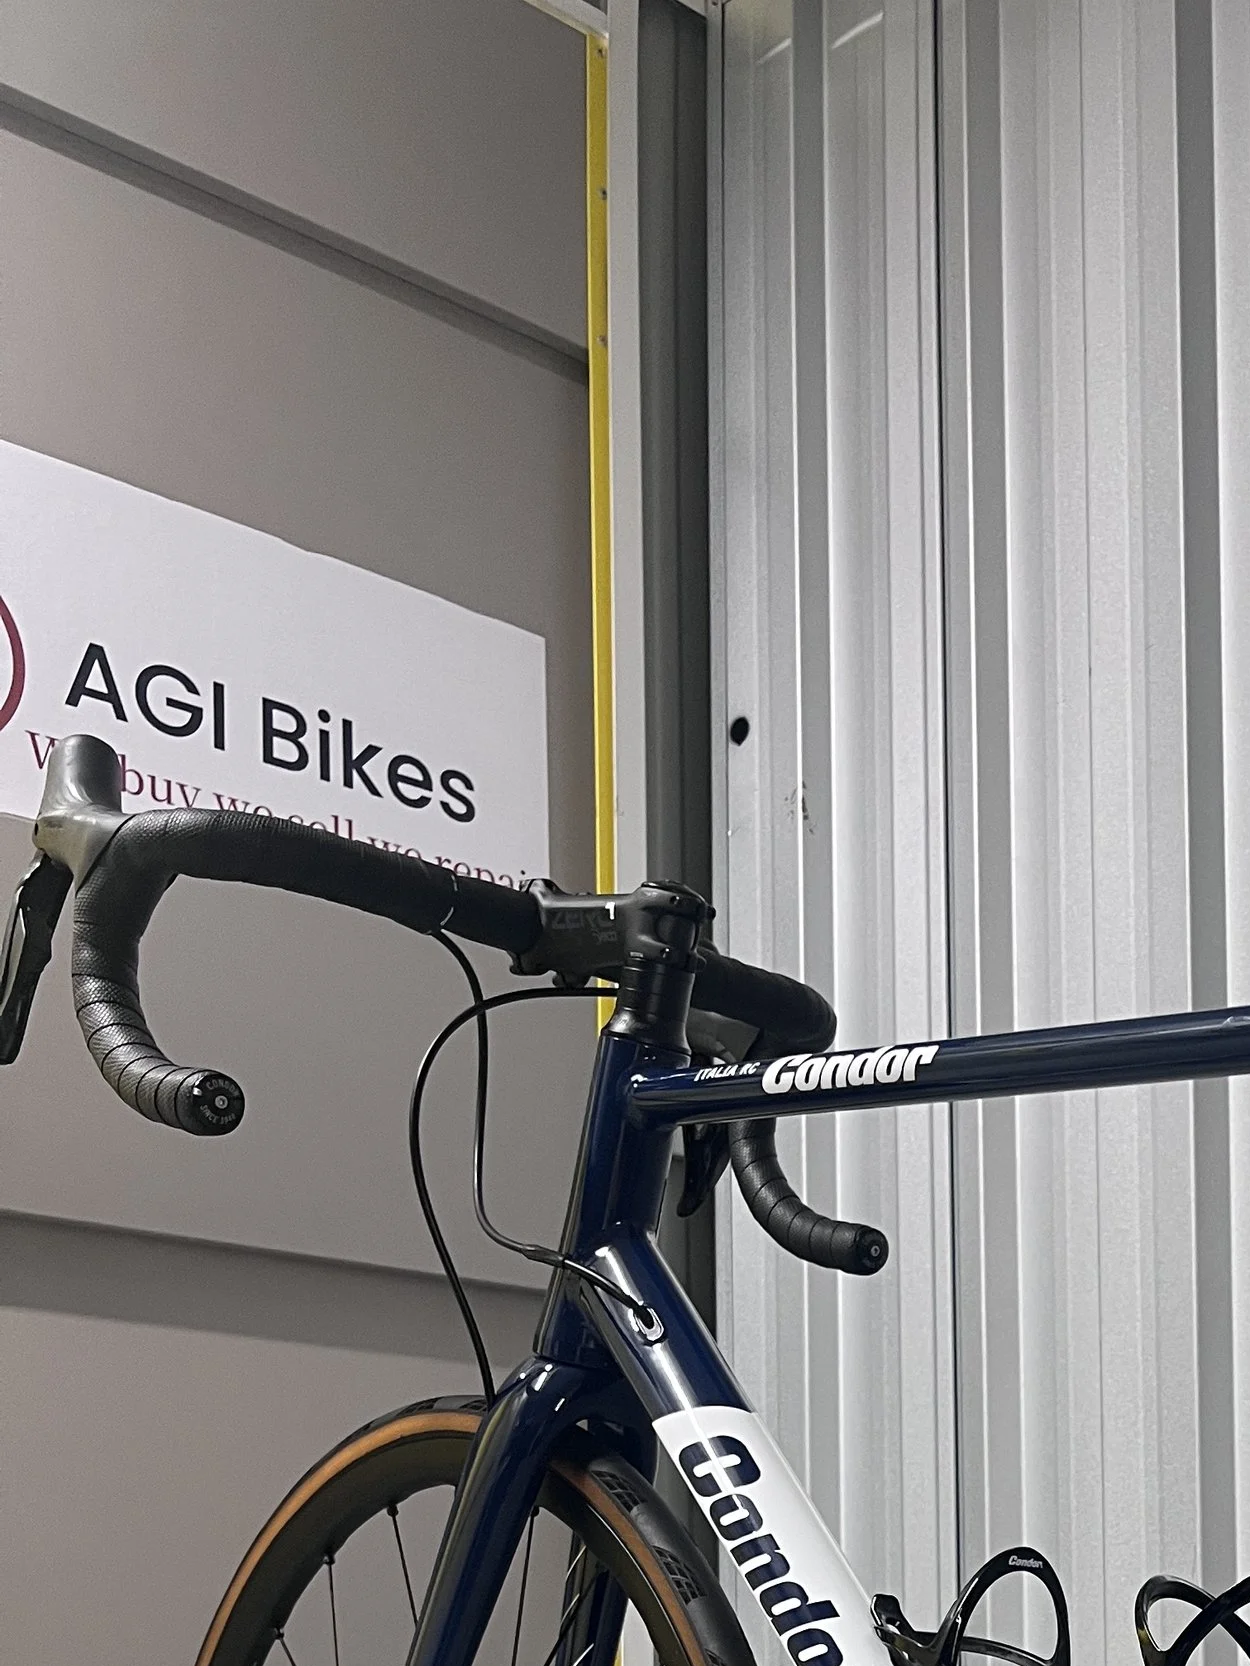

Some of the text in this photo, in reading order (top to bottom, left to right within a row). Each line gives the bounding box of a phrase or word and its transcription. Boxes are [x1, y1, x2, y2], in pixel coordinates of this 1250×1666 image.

[65, 642, 476, 824] AGI Bikes
[693, 1061, 761, 1082] ITALIA RC
[761, 1044, 940, 1095] Condor
[1008, 1555, 1044, 1569] Condor
